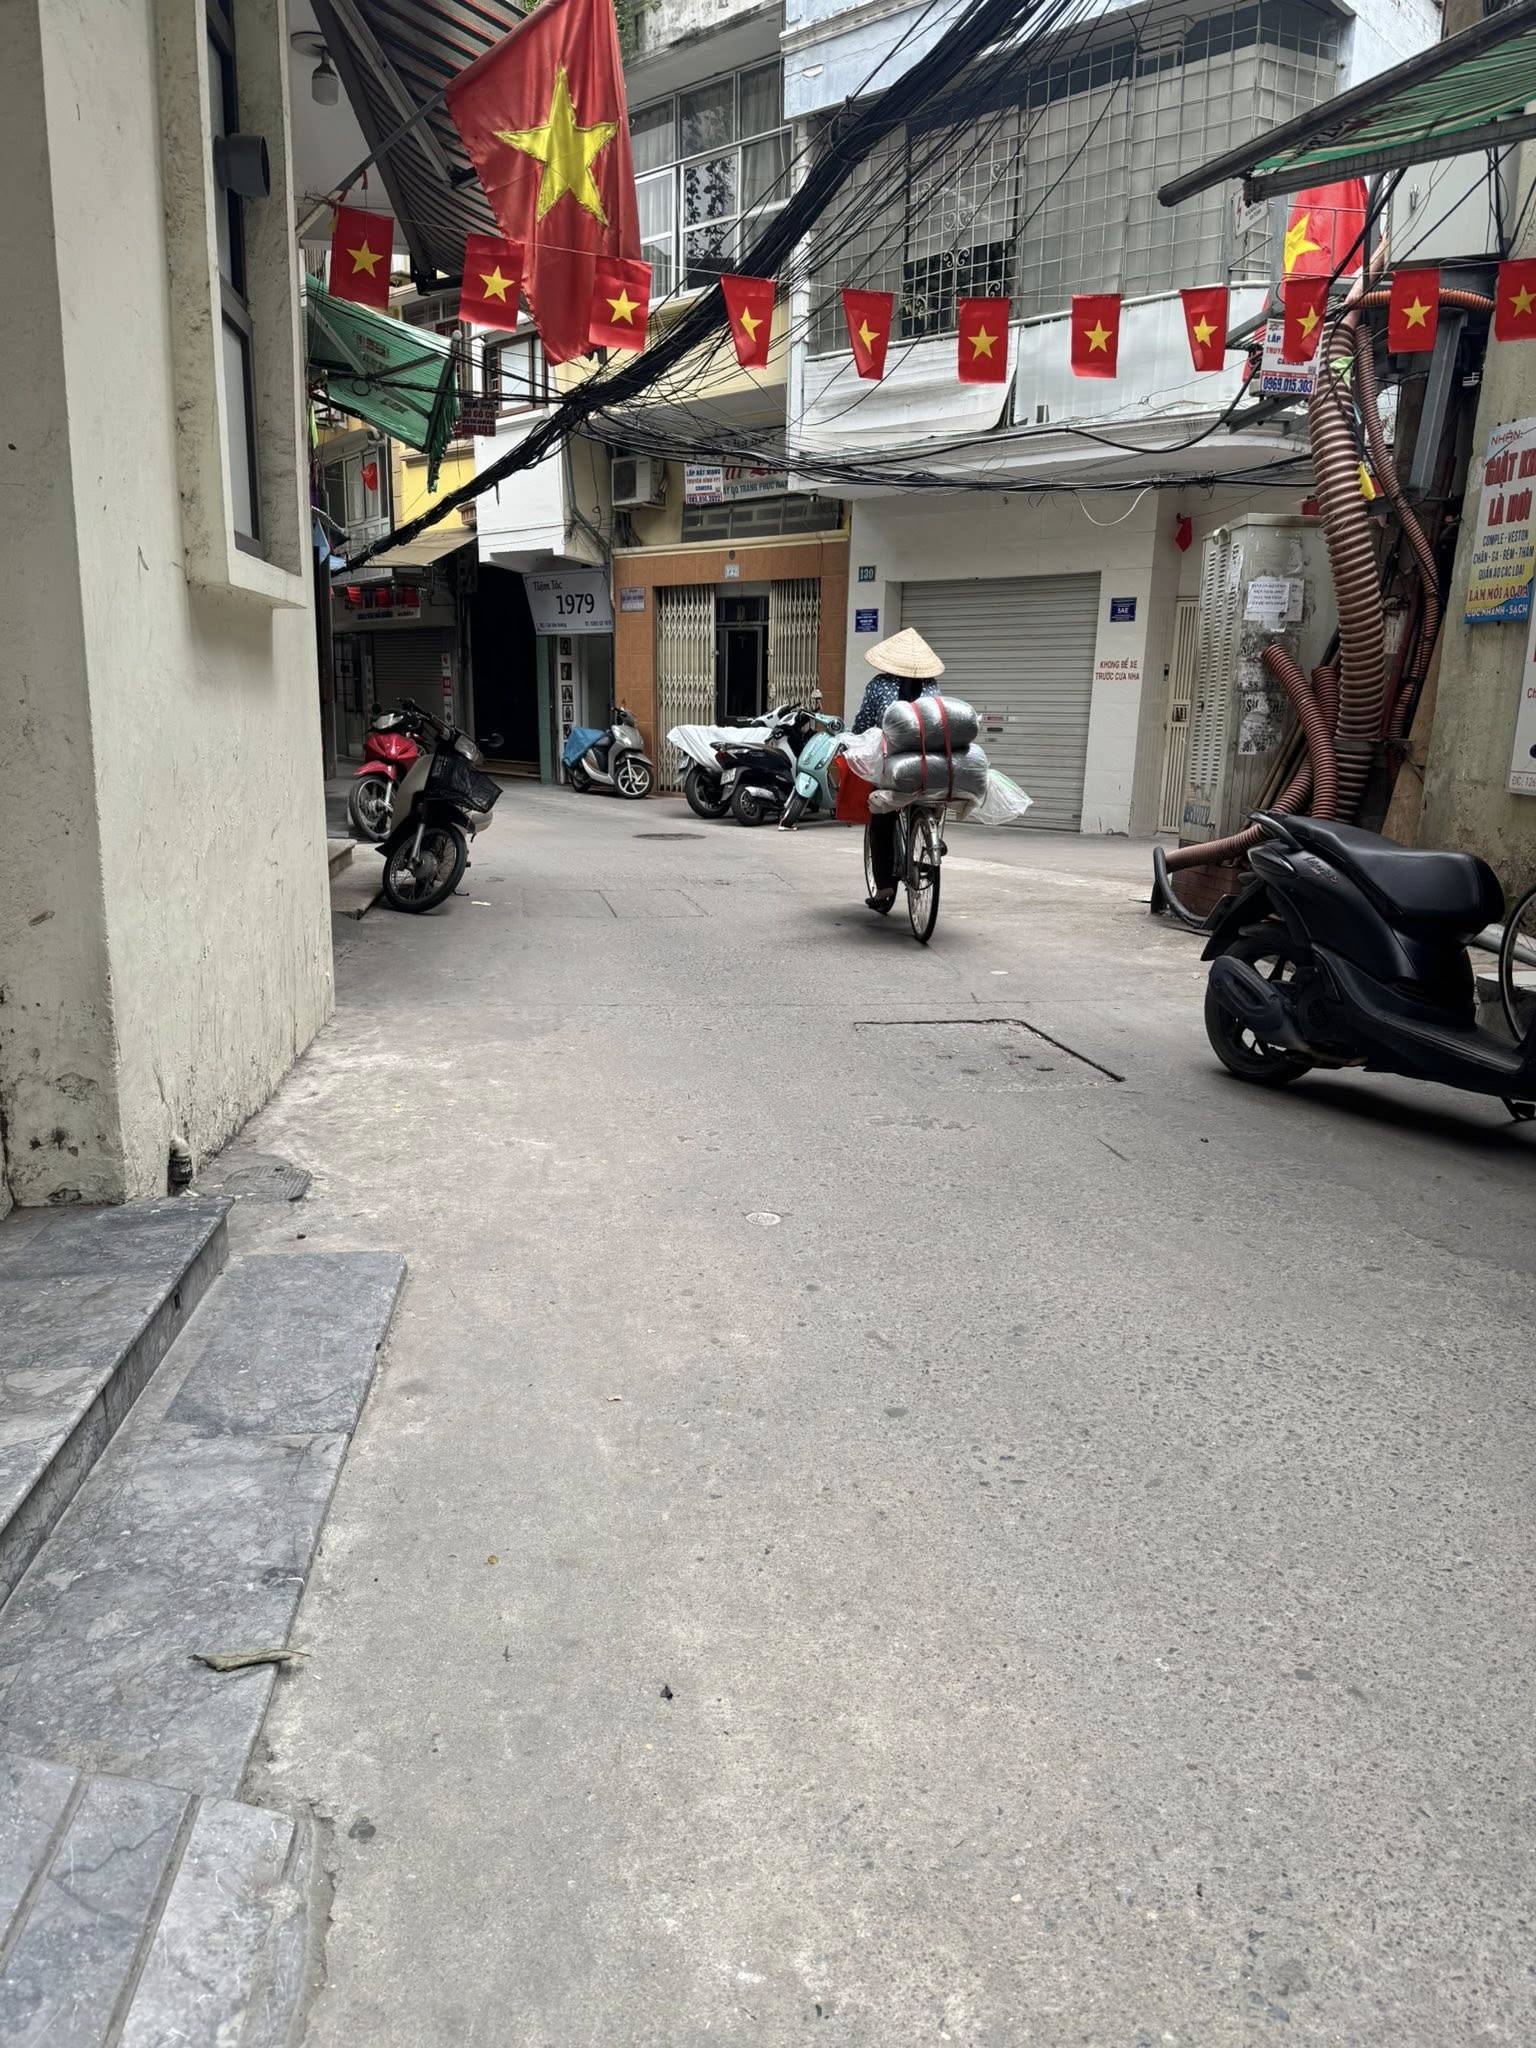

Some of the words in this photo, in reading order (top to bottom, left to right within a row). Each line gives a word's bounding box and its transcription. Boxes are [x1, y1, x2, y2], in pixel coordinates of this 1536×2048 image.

[1263, 376, 1313, 393] 0969.015.303
[860, 568, 874, 580] 130
[556, 593, 595, 615] 1979
[1130, 660, 1138, 669] XE
